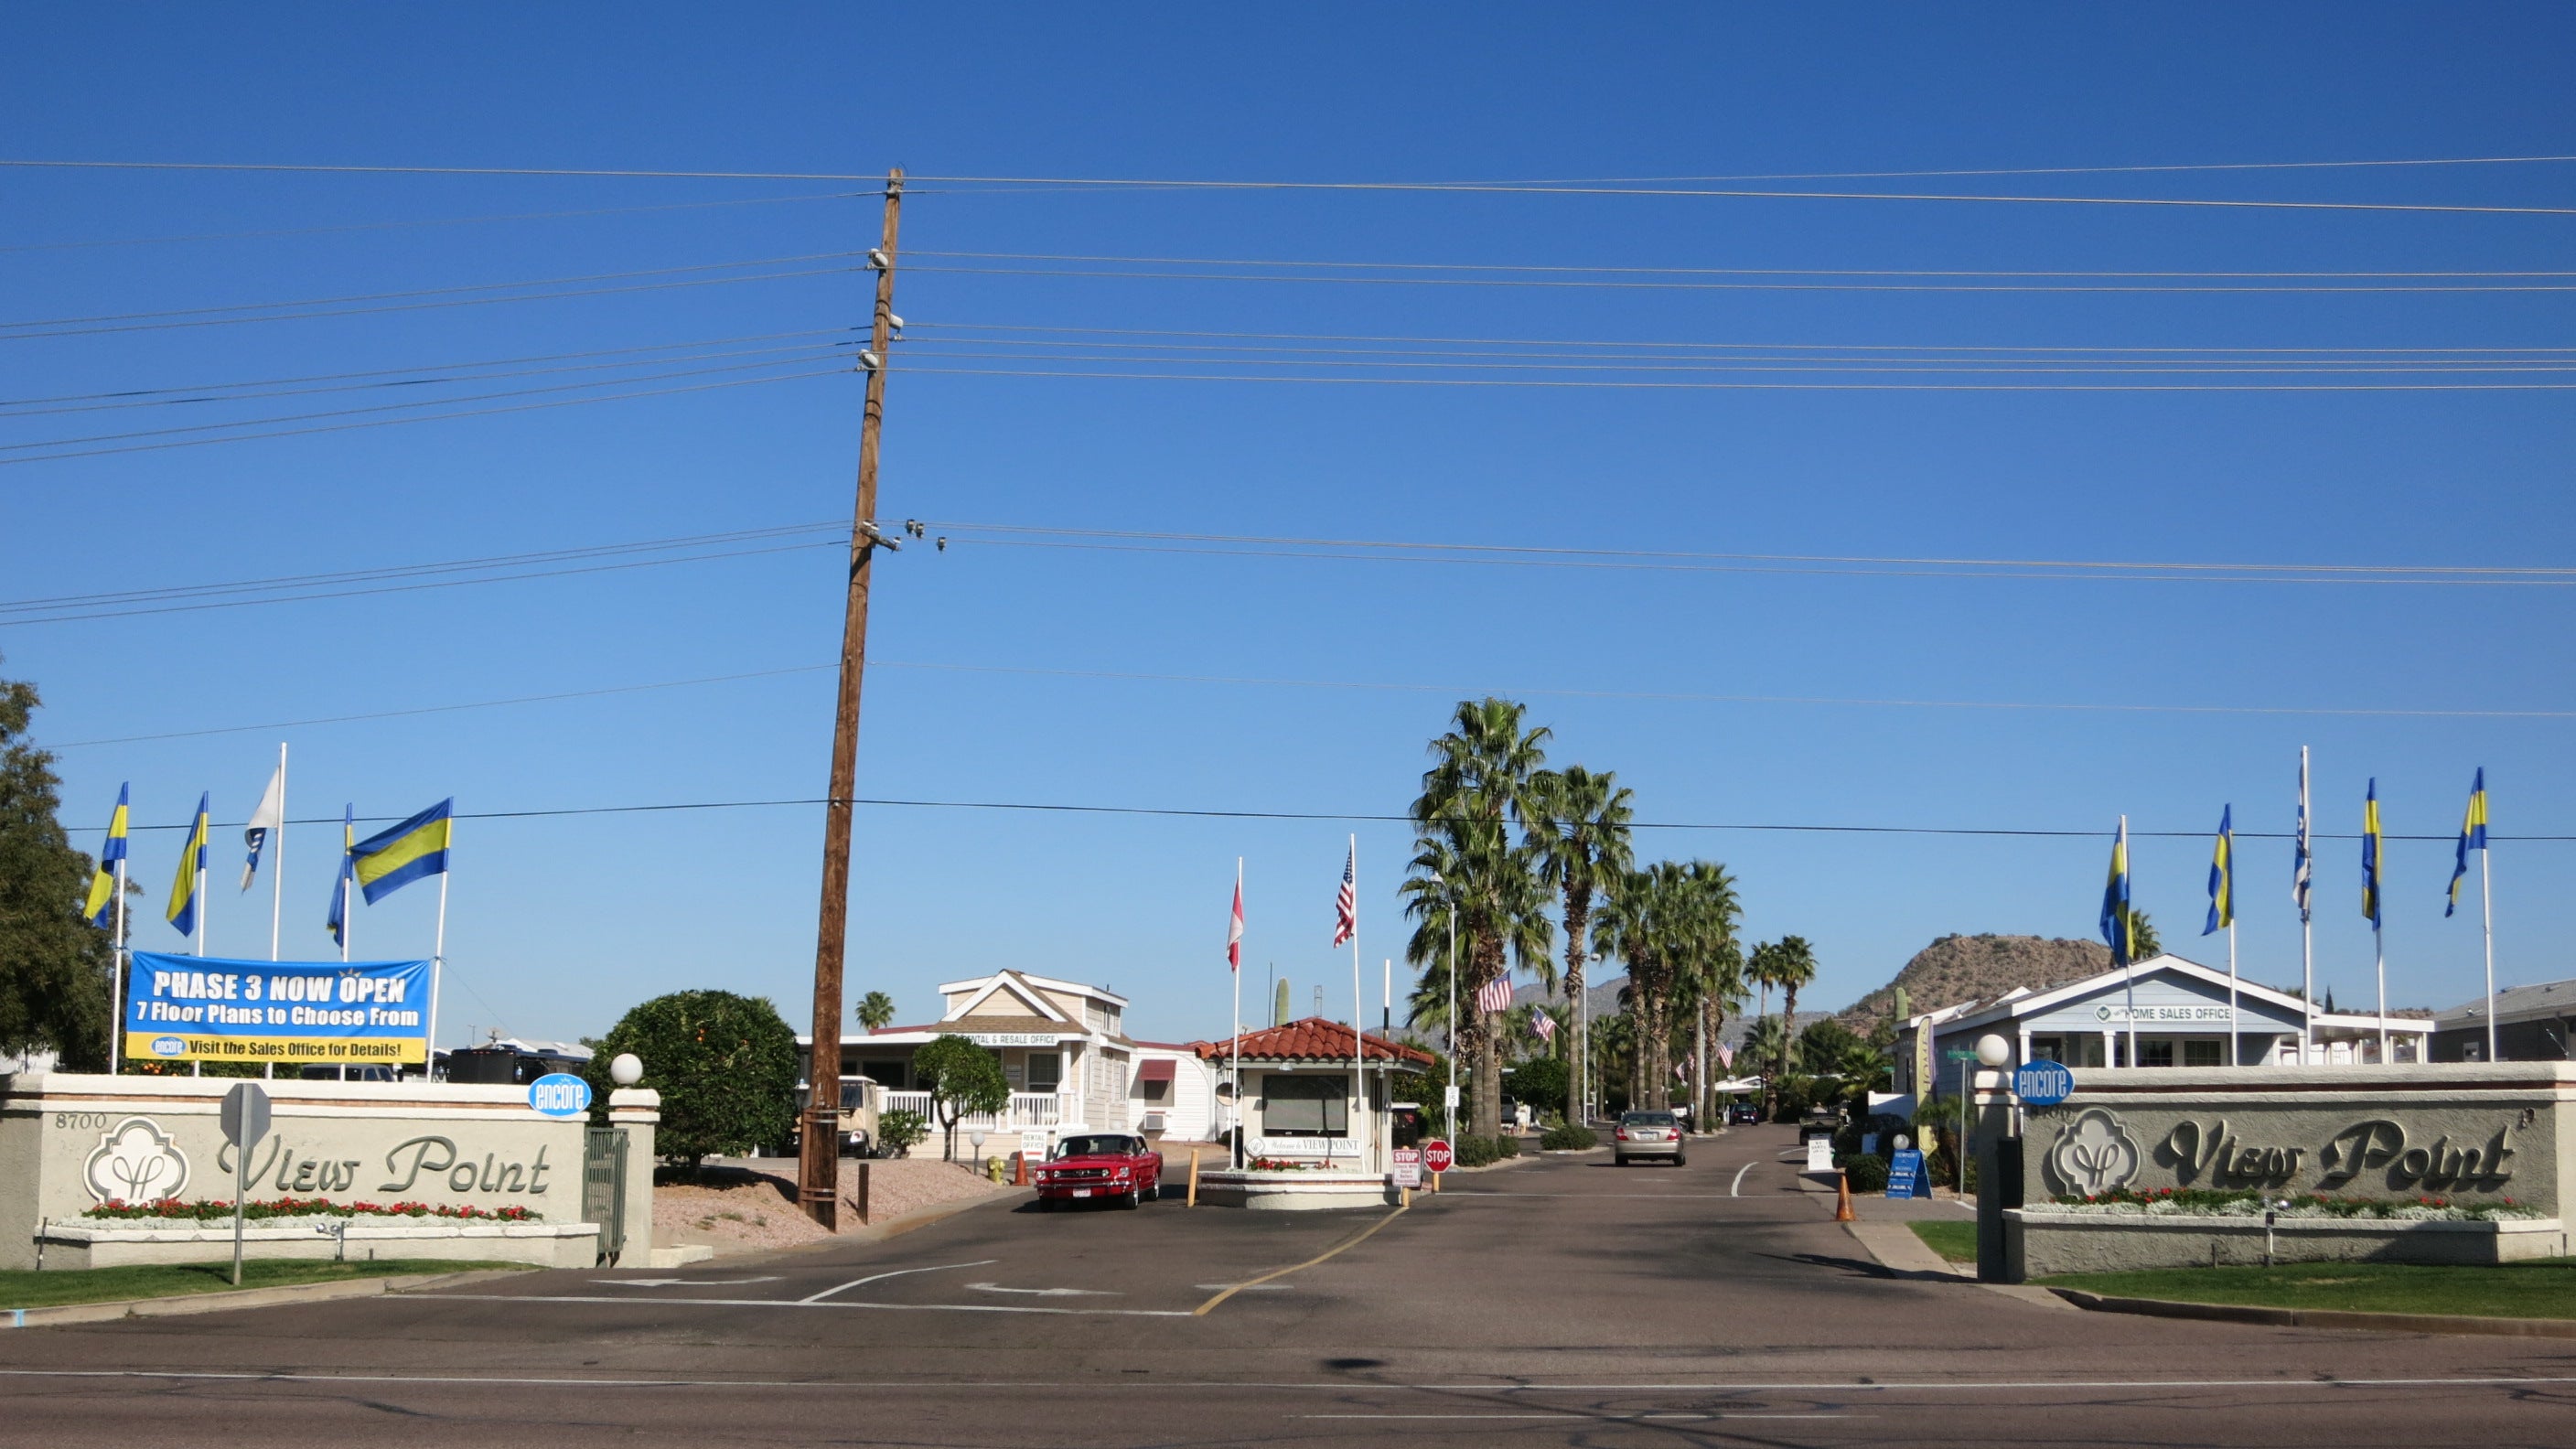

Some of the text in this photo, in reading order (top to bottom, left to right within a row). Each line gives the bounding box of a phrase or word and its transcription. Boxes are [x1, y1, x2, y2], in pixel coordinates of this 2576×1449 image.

[153, 971, 406, 1004] PHASE 3 NOW OPEN
[136, 1001, 419, 1026] 7 Floor Plans to Choose From
[2159, 1008, 2192, 1019] SALES
[2195, 1008, 2230, 1019] OFFICE
[992, 1035, 998, 1044] &
[1000, 1035, 1028, 1044] RESALE
[1030, 1035, 1056, 1044] OFFICE
[155, 1040, 402, 1057] encore Visit the Sales Office for Details!
[2019, 1070, 2067, 1098] encore
[535, 1084, 585, 1110] encore
[55, 1113, 107, 1130] 8700
[1023, 1142, 1046, 1150] OFFICE
[2170, 1119, 2517, 1180] View Point
[216, 1133, 551, 1194] View Point
[1395, 1153, 1418, 1162] STOP
[1426, 1151, 1450, 1163] STOP
